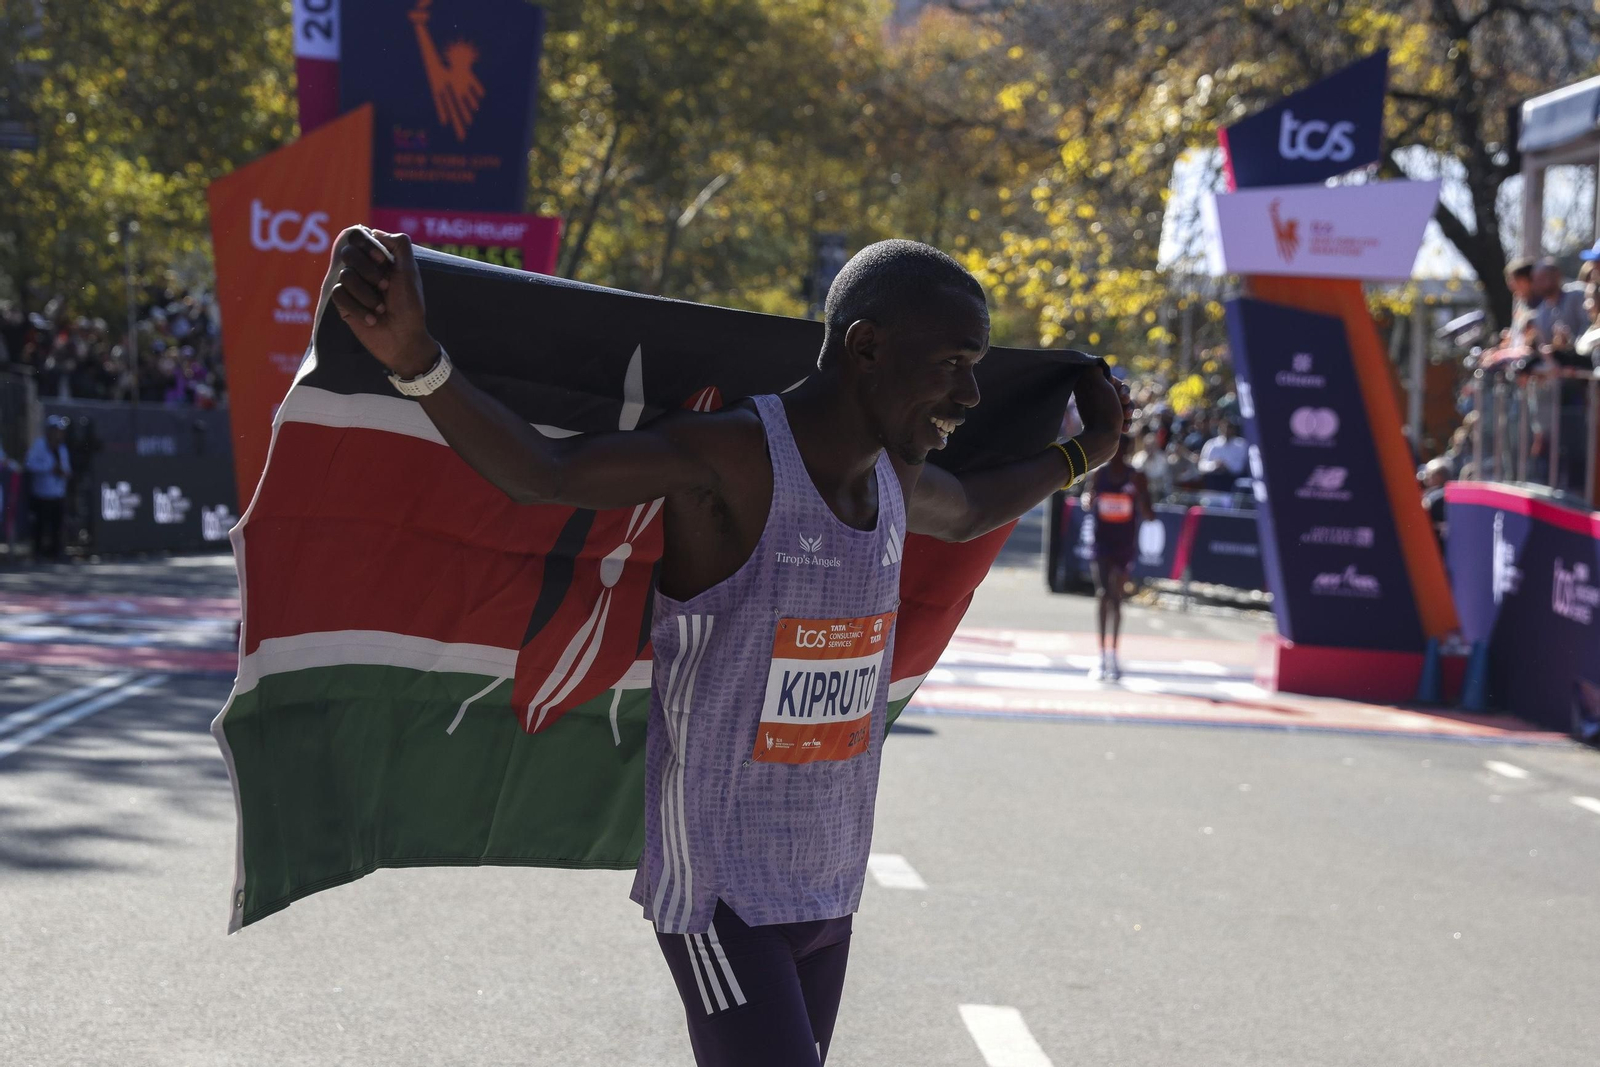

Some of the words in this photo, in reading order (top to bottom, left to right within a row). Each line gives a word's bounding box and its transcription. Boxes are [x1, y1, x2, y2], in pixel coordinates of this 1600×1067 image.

[1278, 108, 1355, 162] tcs
[250, 197, 330, 253] tcs
[775, 551, 811, 567] Tirop's
[811, 555, 841, 568] Angels
[795, 624, 827, 648] tcs
[829, 631, 864, 640] CONSULTANCY
[830, 624, 847, 632] TATA
[828, 640, 852, 648] SERVICES
[870, 634, 882, 644] TATA
[777, 664, 876, 718] KIPRUTO
